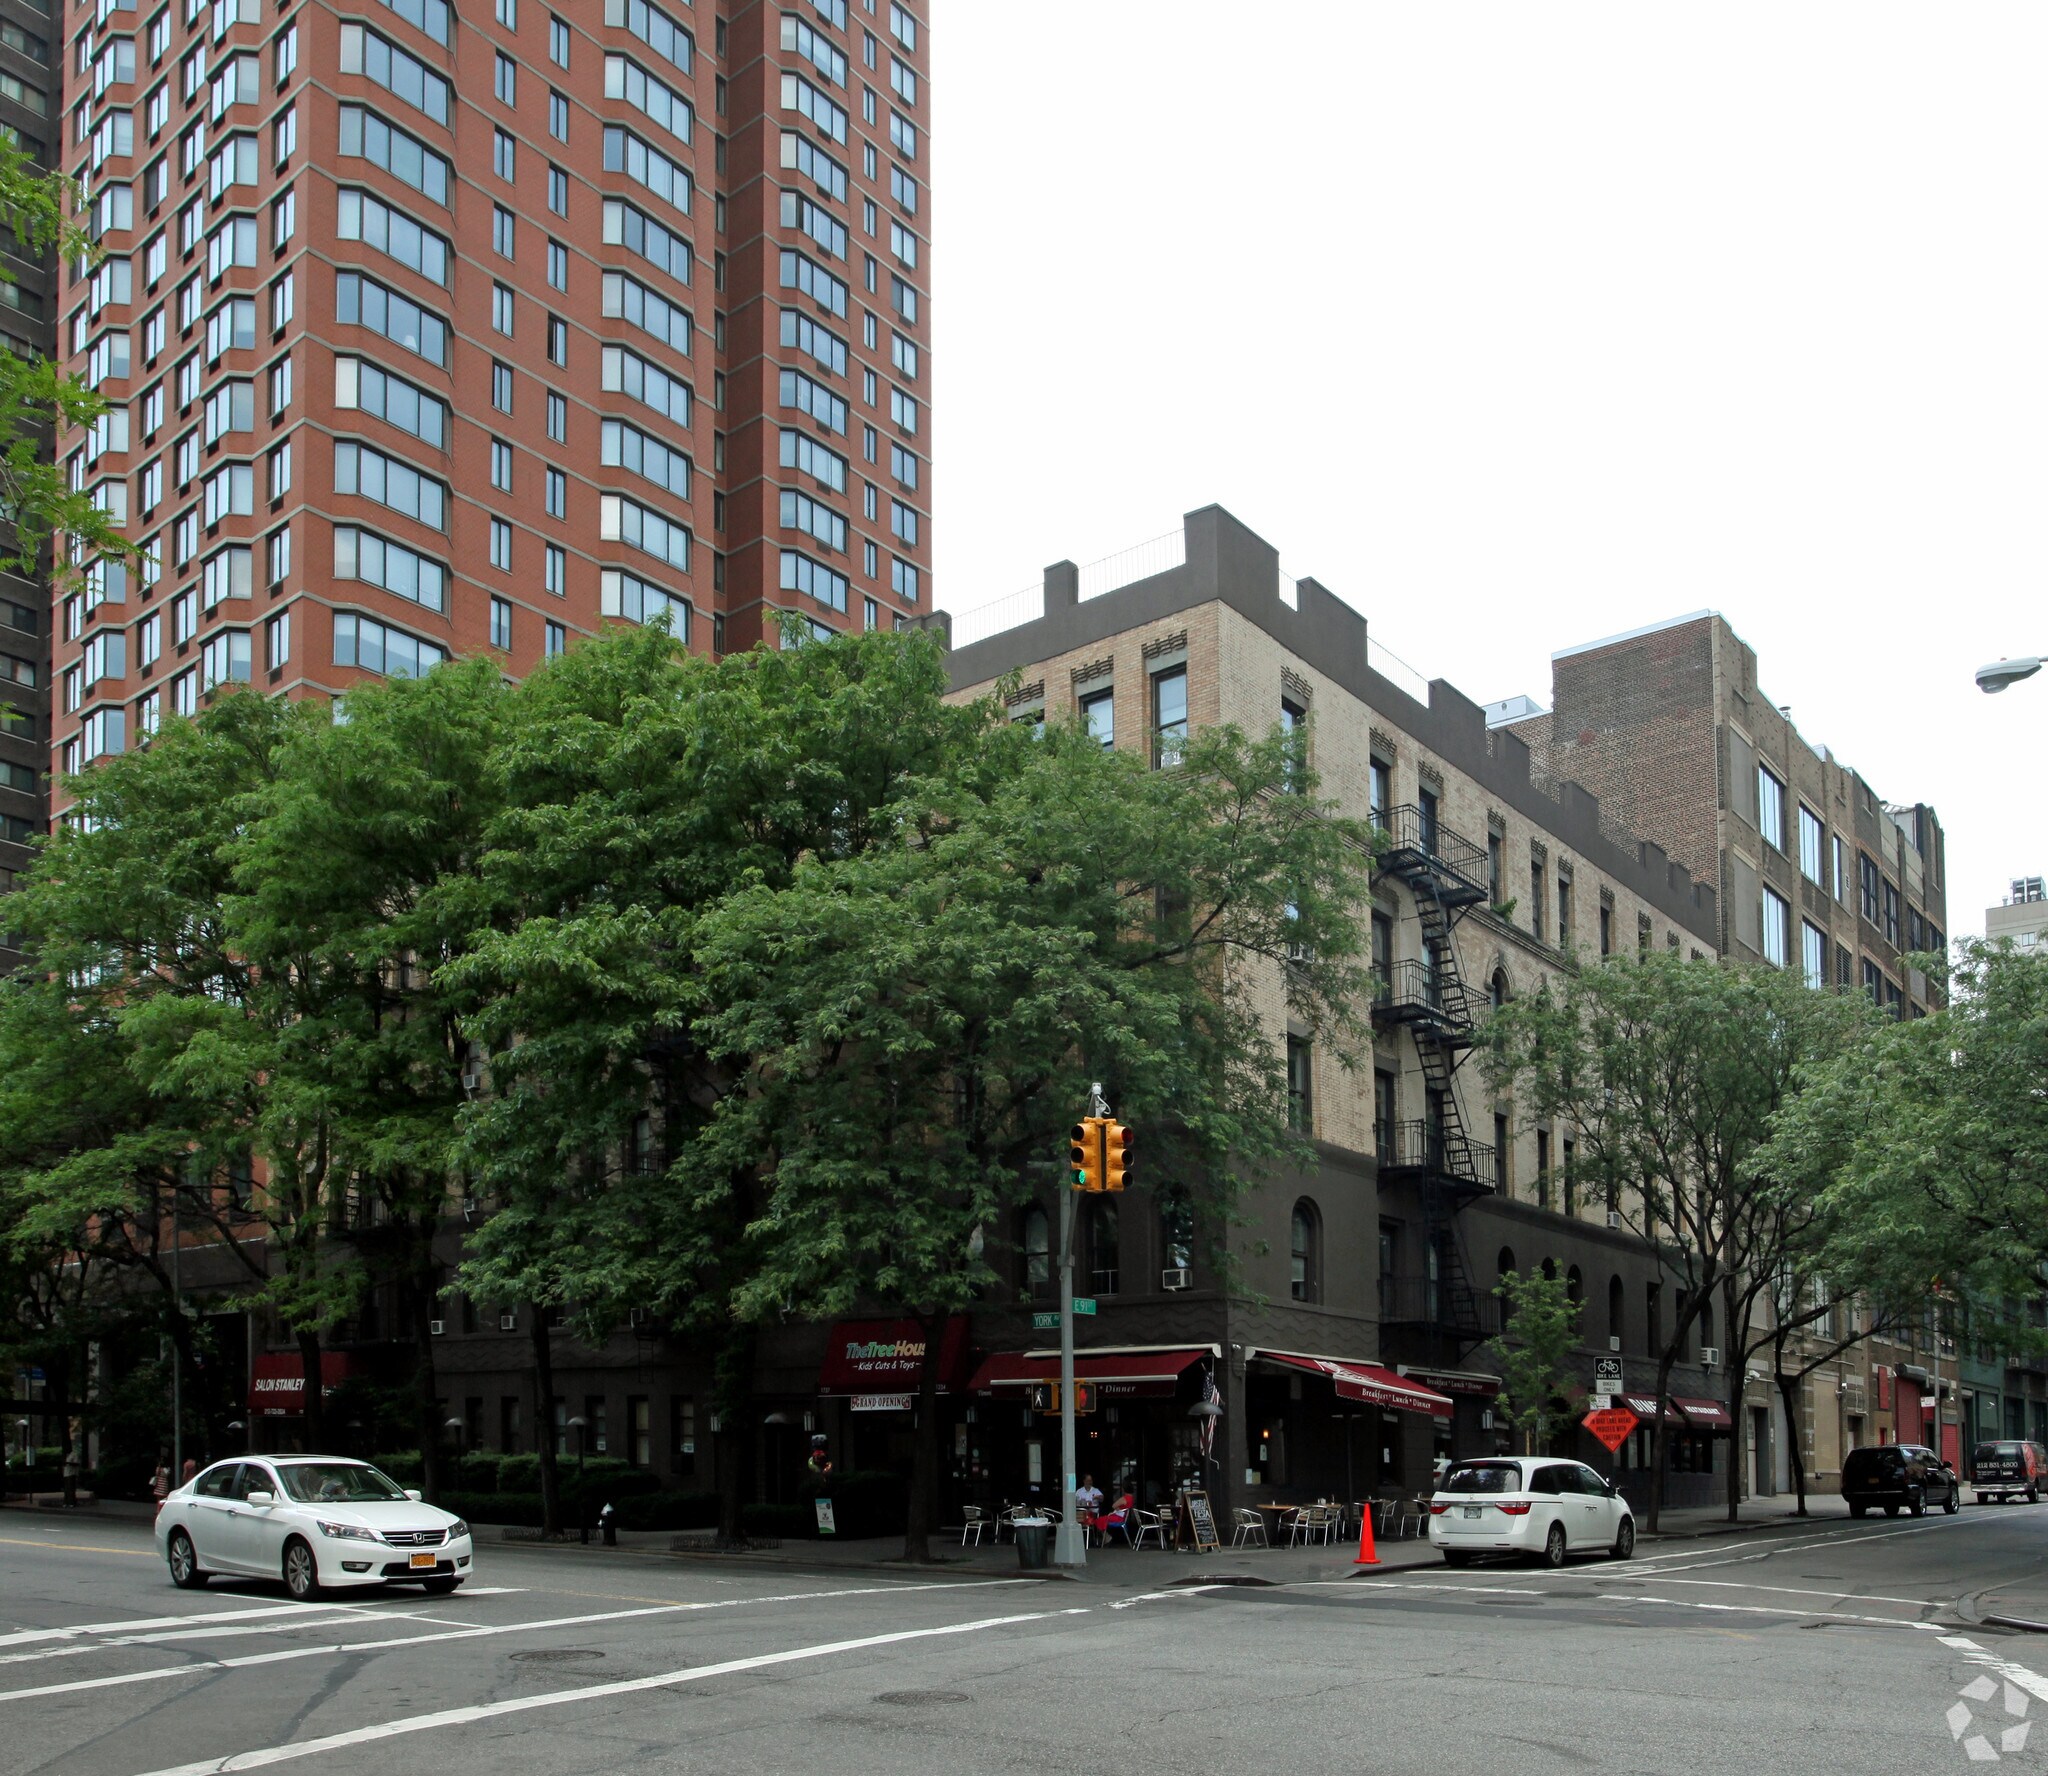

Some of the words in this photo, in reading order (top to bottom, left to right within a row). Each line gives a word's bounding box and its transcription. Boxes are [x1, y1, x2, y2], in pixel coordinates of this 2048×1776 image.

[1074, 1300, 1079, 1311] E
[1034, 1315, 1053, 1327] YORK
[874, 1361, 891, 1370] Cuts
[891, 1360, 897, 1369] &
[899, 1361, 915, 1370] Toys
[255, 1379, 275, 1391] SALON
[275, 1379, 306, 1391] STANLEY
[1105, 1385, 1137, 1394] Dinner
[1451, 1380, 1465, 1388] Lunch
[855, 1396, 877, 1409] GRAND
[878, 1395, 907, 1408] OPENING
[1361, 1388, 1389, 1402] Breakfast
[1392, 1395, 1409, 1405] Lunch
[1412, 1398, 1431, 1409] Dinner
[1627, 1398, 1671, 1416] DINE
